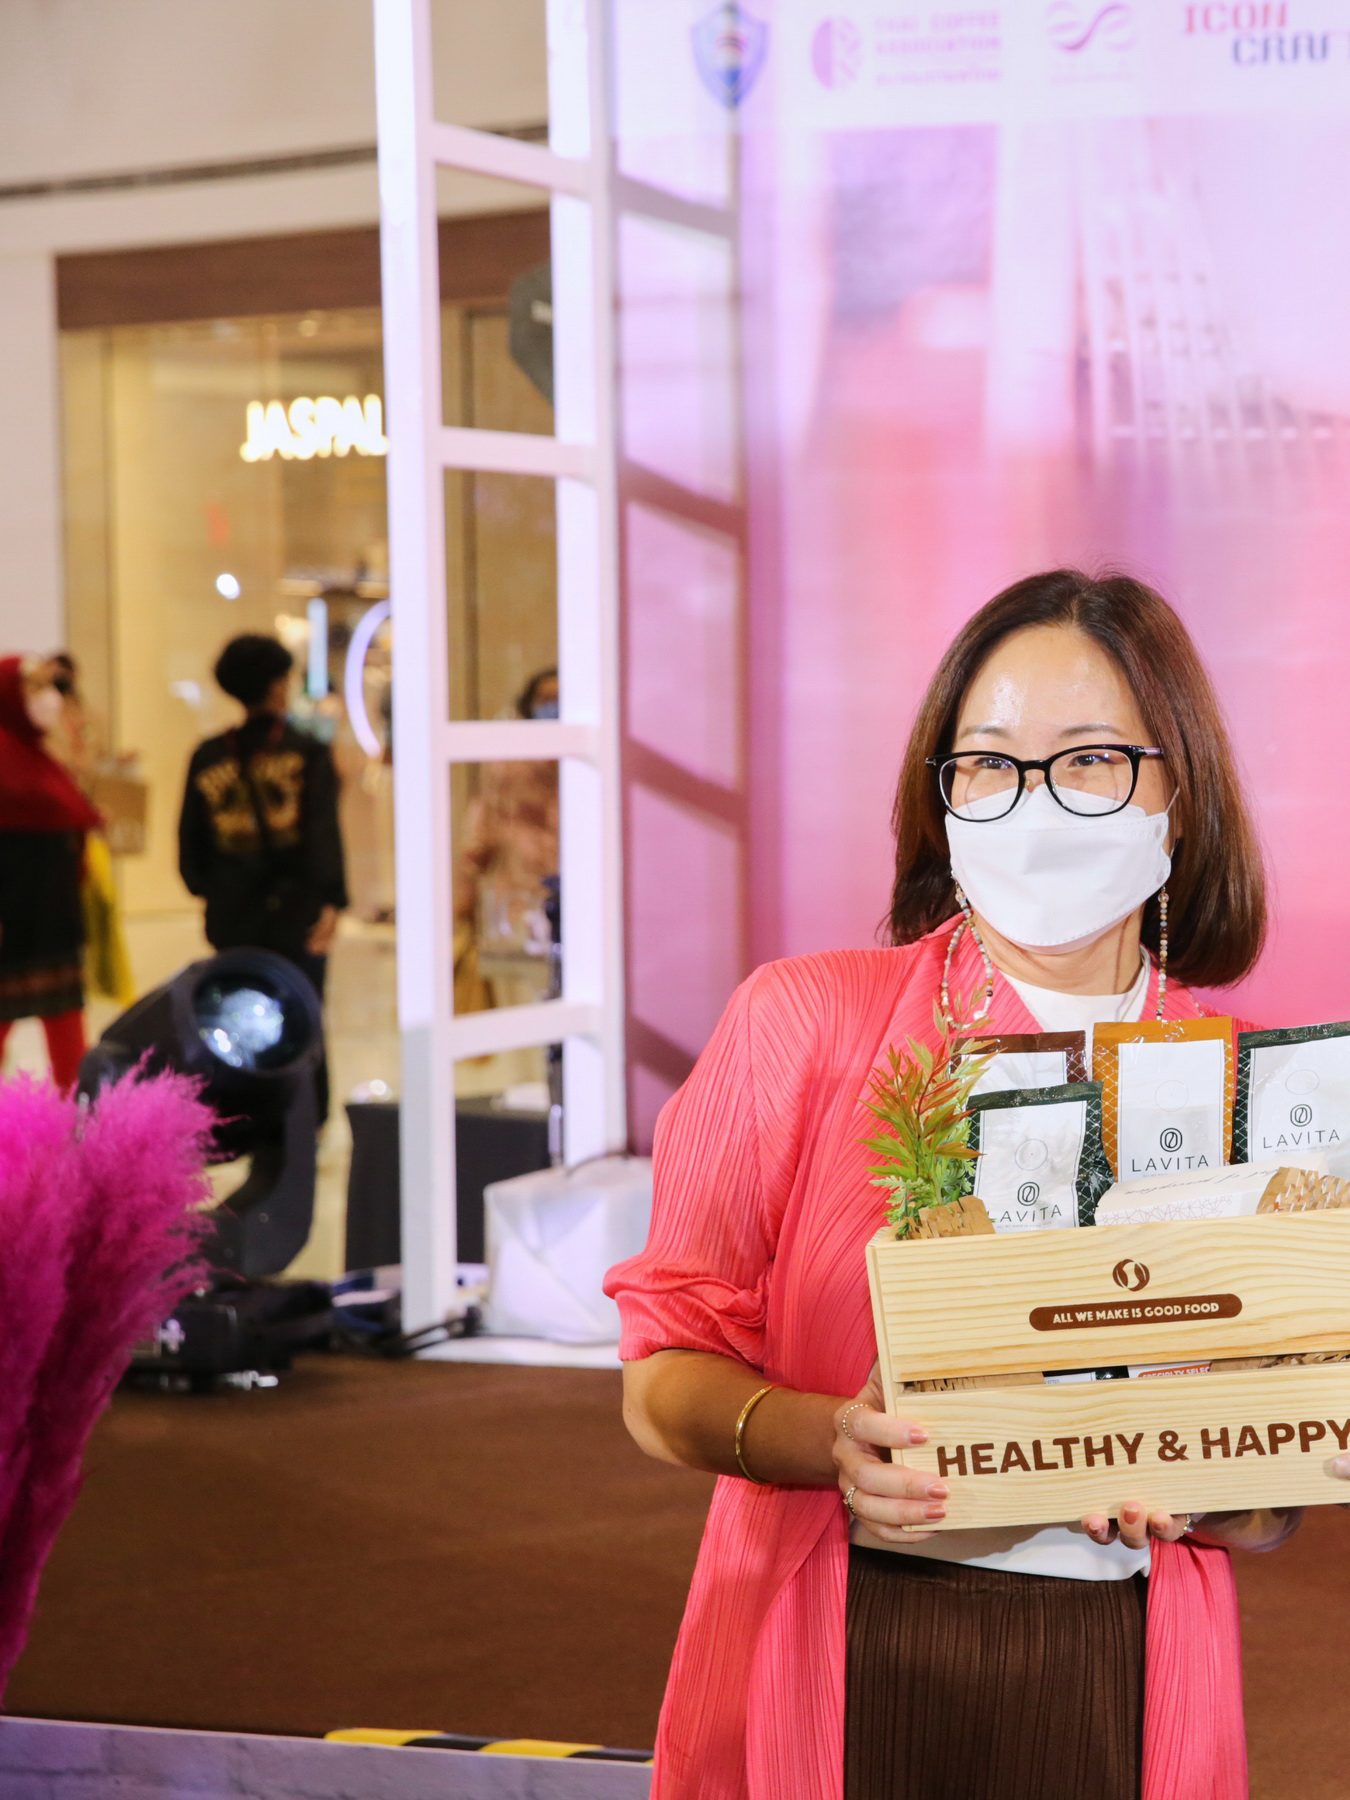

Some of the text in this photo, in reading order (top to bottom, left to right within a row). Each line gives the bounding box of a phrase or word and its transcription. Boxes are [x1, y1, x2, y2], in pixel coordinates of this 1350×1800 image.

[1184, 0, 1290, 36] ICON
[241, 394, 390, 462] JASPAL
[1263, 1130, 1340, 1149] LAVITA
[1131, 1153, 1209, 1173] LAVITA
[1053, 1302, 1220, 1325] ALL WE MAKE IS GOOD FOOD
[937, 1432, 1145, 1477] HEALTHY
[1157, 1431, 1188, 1463] &
